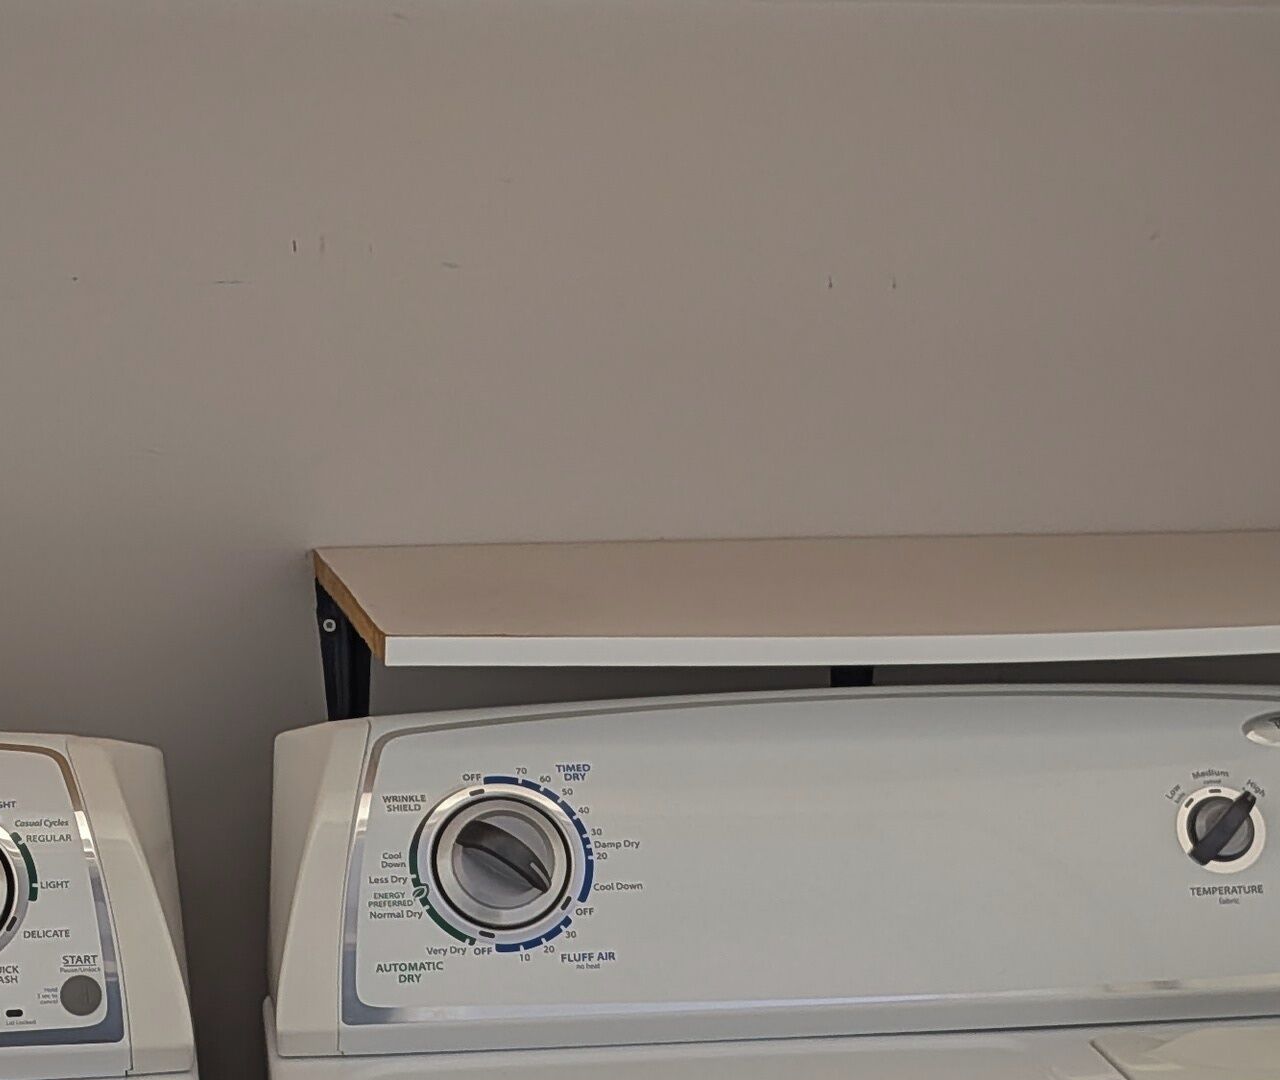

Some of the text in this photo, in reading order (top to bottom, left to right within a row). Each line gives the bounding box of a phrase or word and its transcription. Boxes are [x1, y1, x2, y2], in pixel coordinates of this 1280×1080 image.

[516, 767, 527, 775] 70
[555, 764, 591, 773] TIMED
[462, 773, 481, 781] OFF
[540, 775, 551, 783] 60
[564, 773, 586, 782] DRY
[1191, 769, 1230, 780] Medium
[562, 788, 573, 796] 50
[1165, 784, 1181, 800] Low
[1245, 779, 1266, 798] High
[382, 794, 427, 803] WRINKLE
[386, 804, 421, 813] SHIELD
[578, 806, 590, 814] 40
[14, 818, 69, 828] Casual Cycles
[591, 828, 602, 836] 30
[26, 834, 72, 843] REGULAR
[594, 839, 640, 850] Damp Dry
[382, 852, 402, 860] Cool
[596, 852, 607, 860] 20
[381, 861, 407, 869] Down
[40, 880, 70, 889] LIGHT
[369, 875, 408, 885] Less Dry
[593, 882, 643, 891] Cool Down
[1190, 884, 1264, 897] TEMPERATURE
[373, 892, 406, 900] ENERGY
[370, 909, 423, 920] Normal Dry
[575, 907, 595, 916] OFF
[23, 929, 70, 939] DELICATE
[565, 930, 577, 939] 30
[426, 946, 467, 957] Very Dry
[473, 947, 493, 956] OFF
[543, 945, 555, 954] 20
[62, 954, 98, 965] START
[520, 953, 531, 962] 10
[560, 952, 616, 963] FLUFF AIR
[376, 961, 444, 973] AUTOMATIC
[398, 974, 422, 984] DRY
